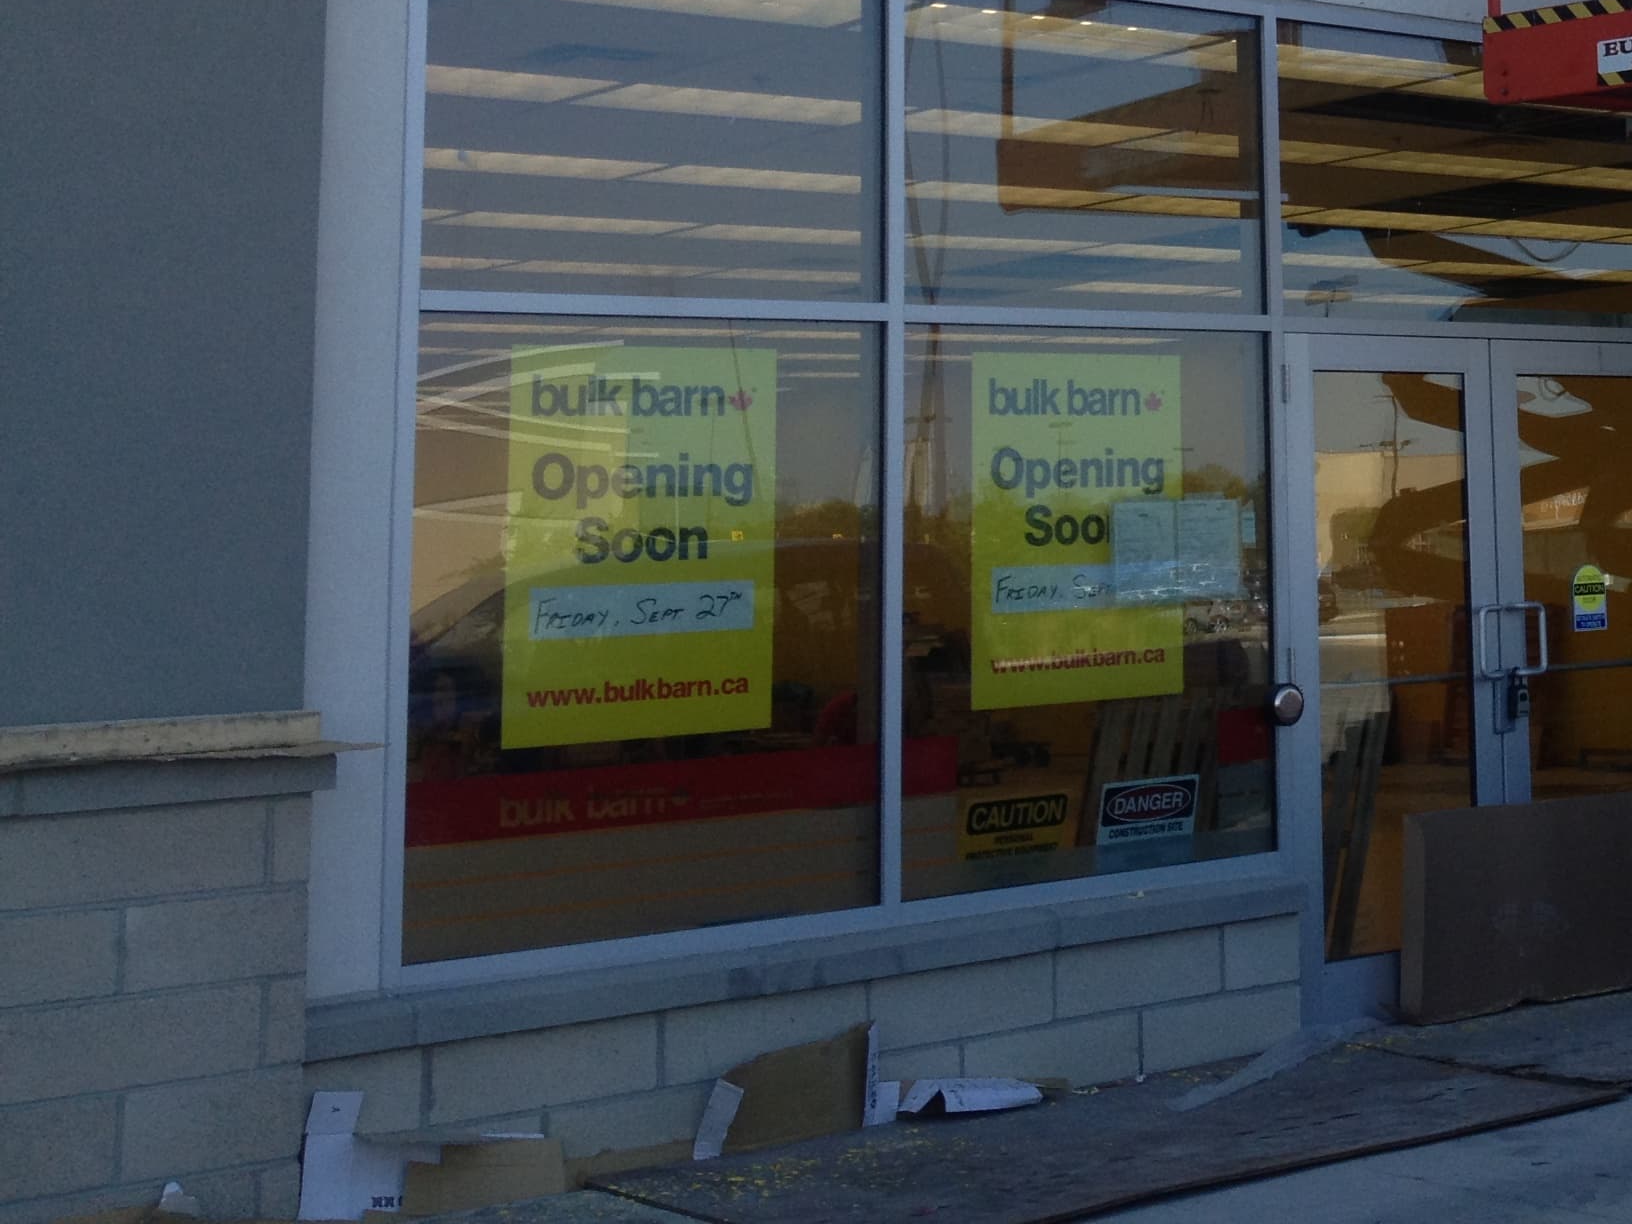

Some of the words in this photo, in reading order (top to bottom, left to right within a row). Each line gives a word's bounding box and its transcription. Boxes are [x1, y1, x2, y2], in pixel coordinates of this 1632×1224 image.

[531, 373, 624, 417] bulk
[632, 378, 725, 417] barn
[989, 378, 1061, 416] bulk
[1067, 380, 1141, 416] barn
[532, 452, 753, 509] Opening
[990, 447, 1164, 497] Opening
[575, 516, 708, 564] Soon
[1025, 505, 1110, 547] Soo
[1575, 583, 1605, 594] CAUTION
[630, 598, 685, 625] SEPT
[991, 647, 1166, 674] www.bulkbarn.ca
[528, 675, 749, 707] www.bulkbarn.ca
[971, 798, 1065, 830] CAUTION
[1114, 791, 1184, 815] DANGER
